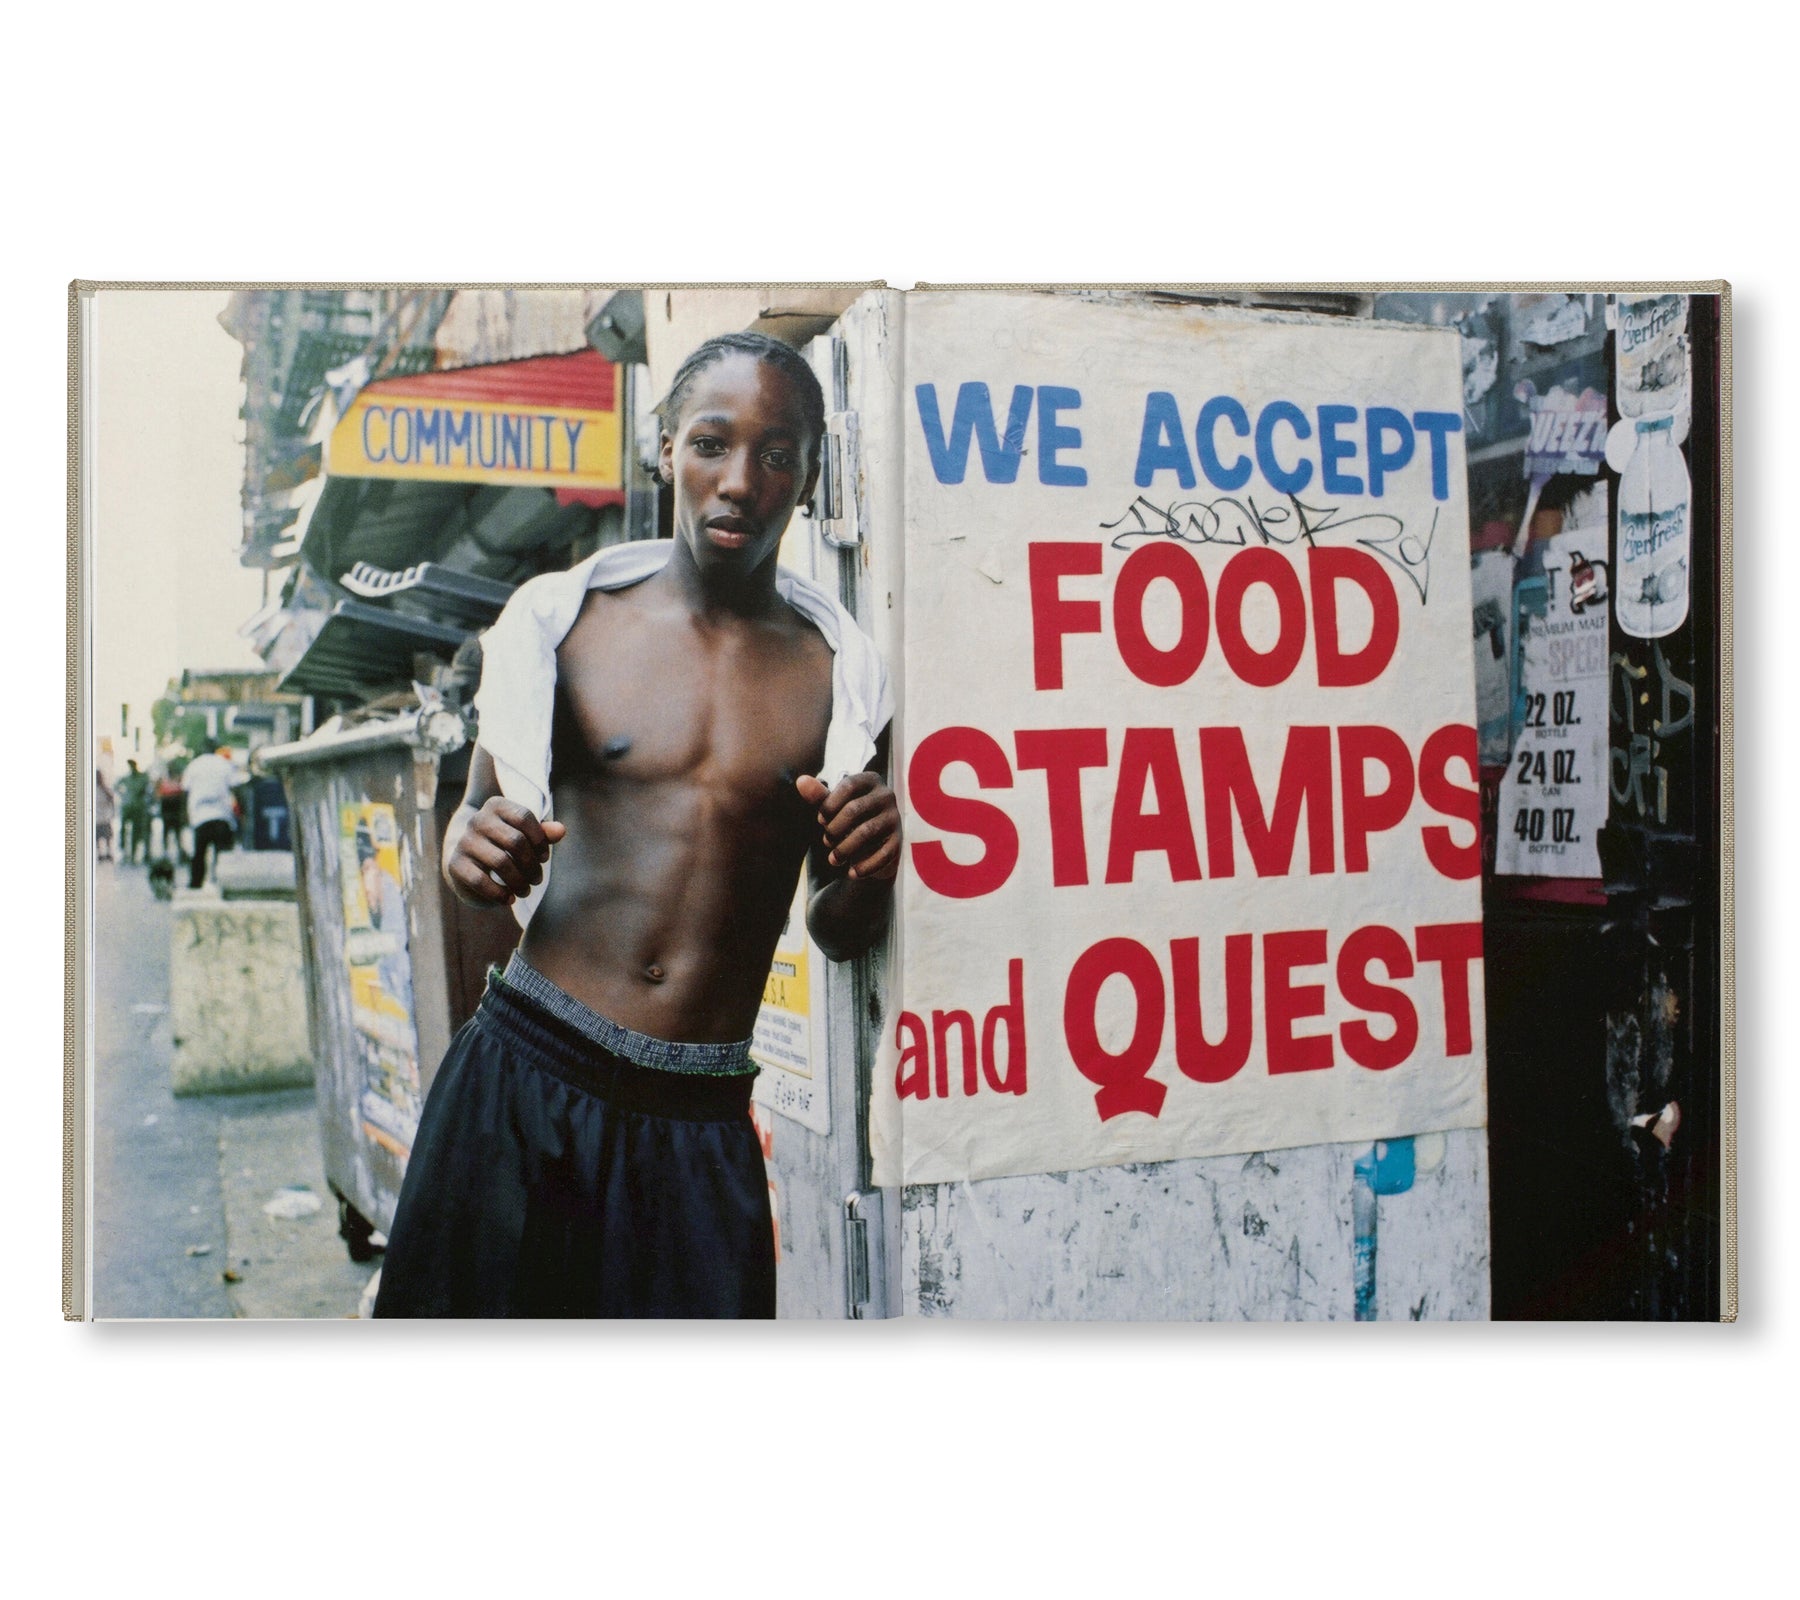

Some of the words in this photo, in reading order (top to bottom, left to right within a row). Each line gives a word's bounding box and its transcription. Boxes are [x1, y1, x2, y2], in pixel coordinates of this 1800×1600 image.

[362, 404, 585, 473] COMMUNITY
[912, 382, 1088, 486] WE
[1134, 392, 1463, 500] ACCEPT
[1622, 509, 1684, 563] Everfresh
[1028, 541, 1400, 690] FOOD
[1578, 615, 1606, 630] MALT
[1525, 690, 1546, 727] 22
[1553, 690, 1581, 726] OZ.
[1535, 728, 1567, 738] BOTTLE
[1517, 751, 1546, 785] 24
[1553, 749, 1581, 784] OZ.
[1541, 786, 1561, 797] CAN
[908, 724, 1482, 899] STAMPS
[1513, 808, 1544, 843] 40
[1552, 807, 1581, 843] OZ.
[1528, 844, 1566, 855] BOTTLE
[894, 957, 1027, 1101] and
[1064, 921, 1484, 1122] QUEST
